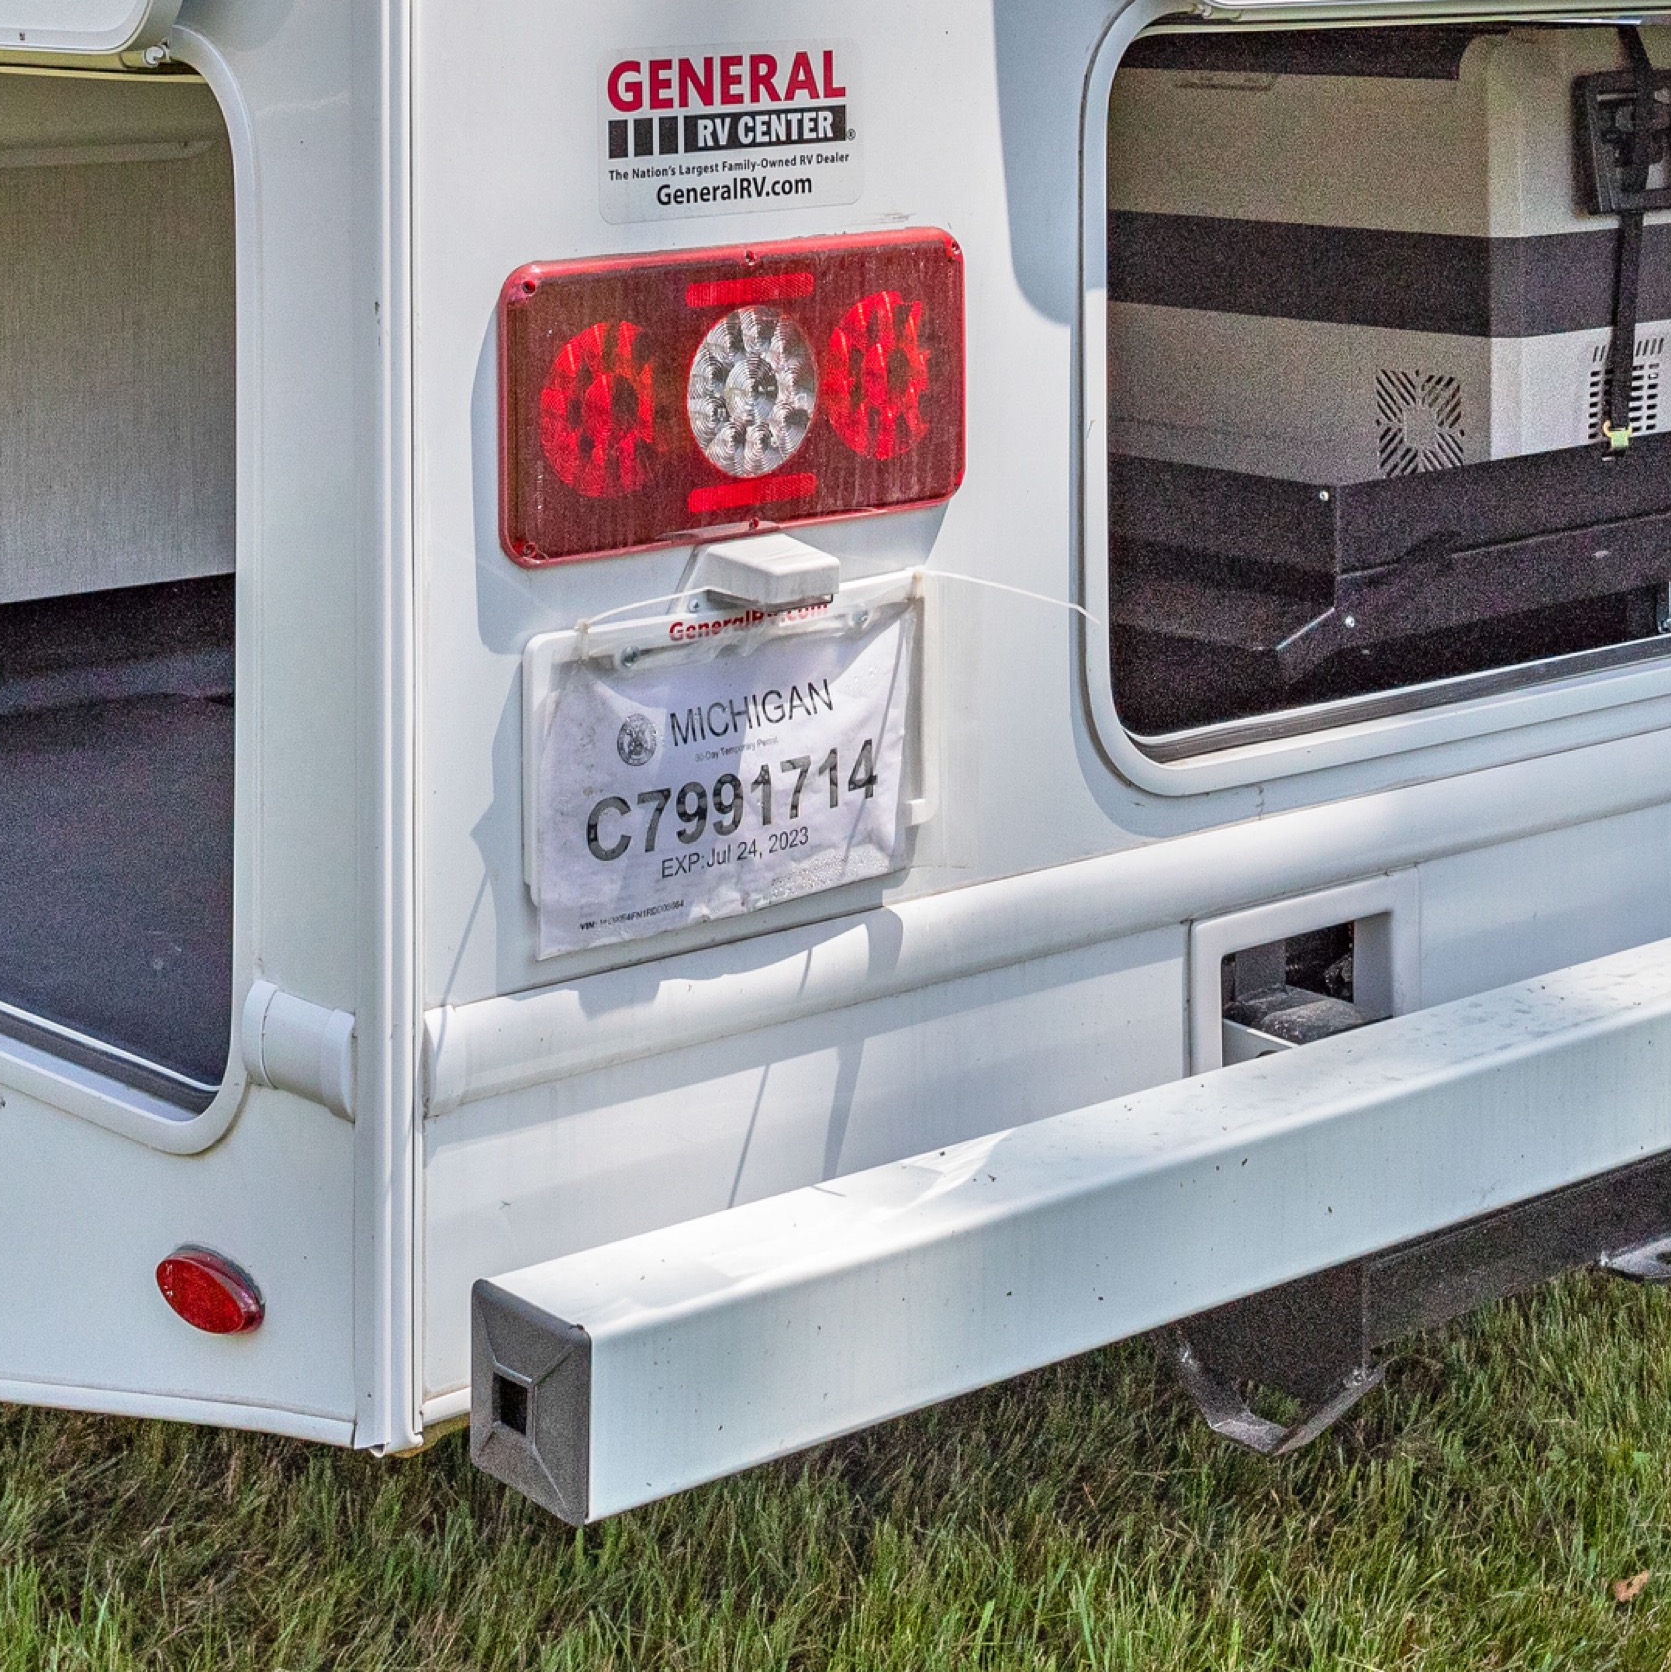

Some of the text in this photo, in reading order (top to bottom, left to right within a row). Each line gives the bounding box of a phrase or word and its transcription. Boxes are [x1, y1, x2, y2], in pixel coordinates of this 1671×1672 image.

[607, 49, 846, 112] GENERAL
[697, 111, 834, 148] RV CENTER
[608, 152, 850, 181] The Nation's Largest Family-Owned RV Dealer
[656, 176, 813, 206] GeneralRV.com
[670, 678, 834, 747] MICHIGAN
[586, 739, 878, 862] C7991714
[737, 838, 762, 861] 24,
[768, 827, 809, 854] 2023
